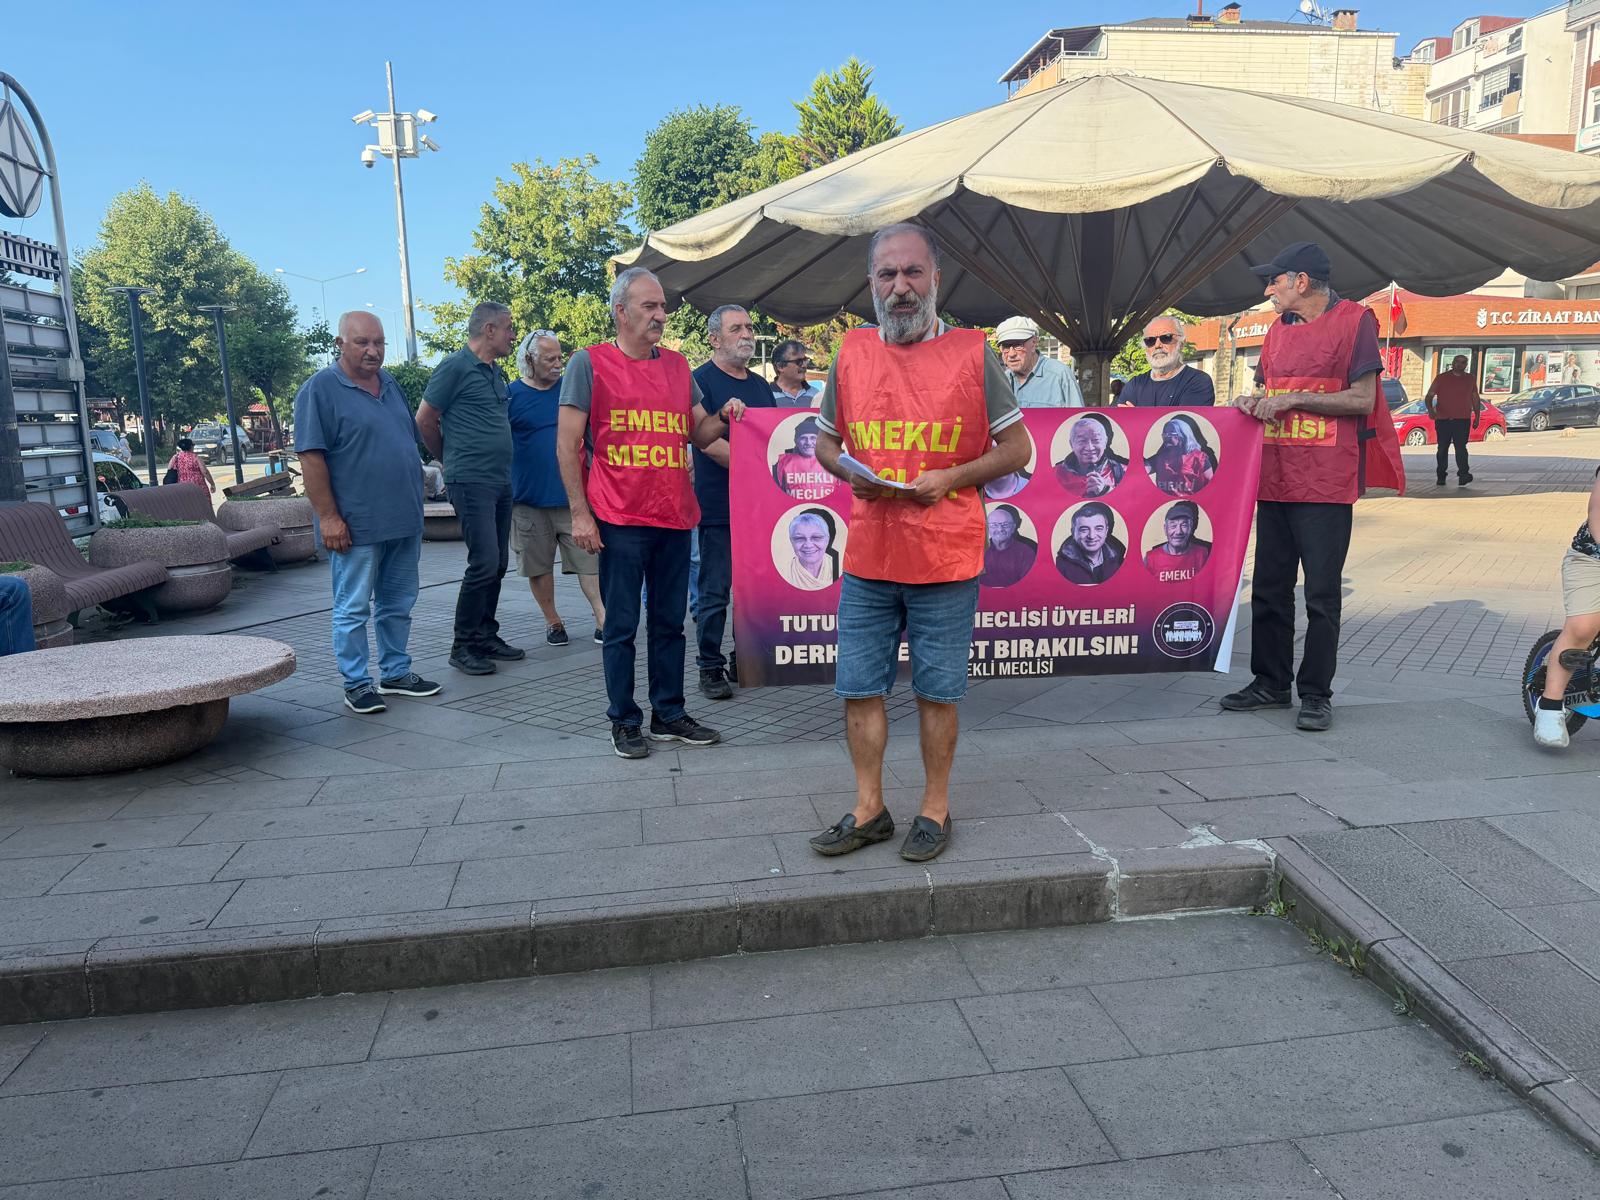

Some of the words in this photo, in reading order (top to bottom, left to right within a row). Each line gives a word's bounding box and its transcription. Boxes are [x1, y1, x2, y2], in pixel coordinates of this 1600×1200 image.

[1490, 311, 1515, 324] T.C.
[1517, 309, 1572, 324] ZİRAAT
[1249, 323, 1273, 337] ZİRA
[780, 614, 839, 633] TUTU
[1051, 604, 1136, 627] ÜYELERİ
[994, 635, 1139, 659] BIRAKILSIN!
[999, 658, 1054, 676] MECLİSİ
[1565, 694, 1587, 706] BMX
